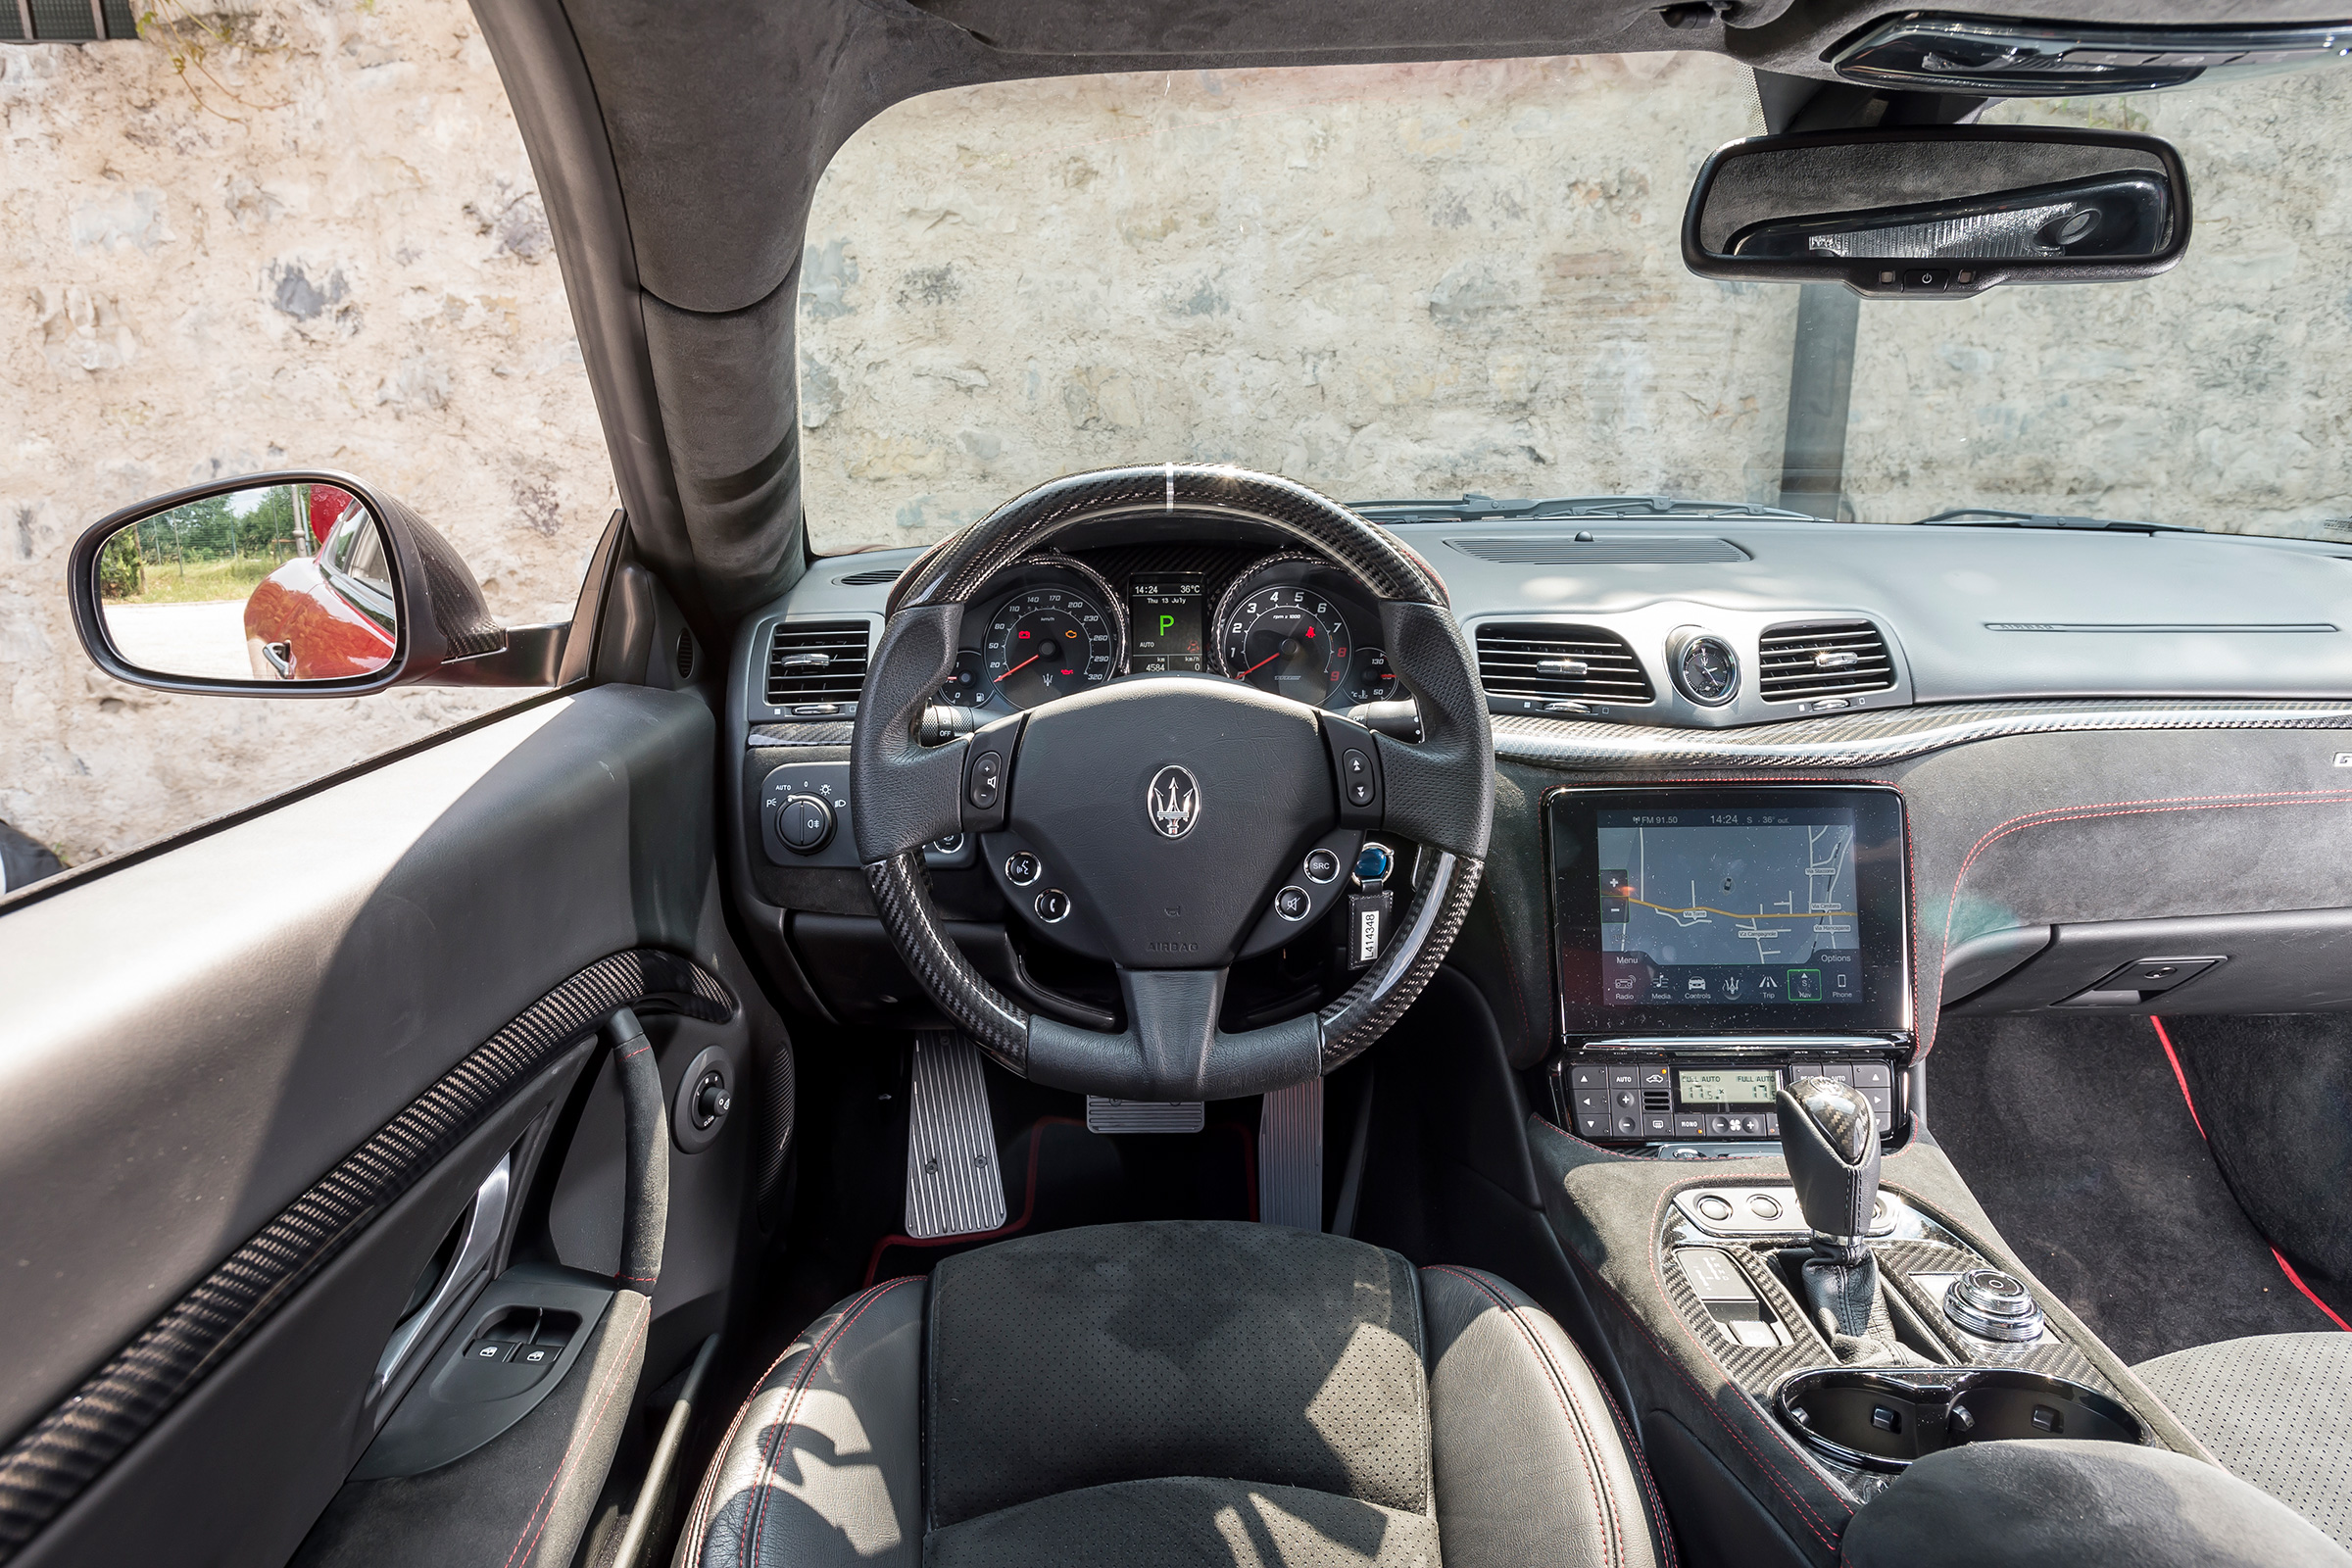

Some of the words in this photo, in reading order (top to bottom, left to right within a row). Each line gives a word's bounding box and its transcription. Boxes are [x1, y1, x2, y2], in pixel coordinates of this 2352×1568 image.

[1135, 585, 1158, 594] 14:24
[1270, 591, 1279, 602] 4
[1295, 592, 1304, 602] 5
[1247, 603, 1257, 613] 3
[1317, 603, 1328, 613] 6
[1159, 614, 1175, 636] P
[1232, 622, 1243, 634] 2
[1333, 622, 1343, 634] 7
[1230, 647, 1236, 659] 1
[1337, 647, 1347, 658] 8
[1094, 654, 1109, 662] 290
[1146, 663, 1165, 672] 4584
[1194, 662, 1200, 671] 0
[1330, 671, 1341, 682] 9
[1710, 815, 1739, 824] 14:24
[1365, 913, 1375, 959] L414348
[1146, 942, 1199, 953] AIRBAG
[1821, 954, 1851, 963] Options
